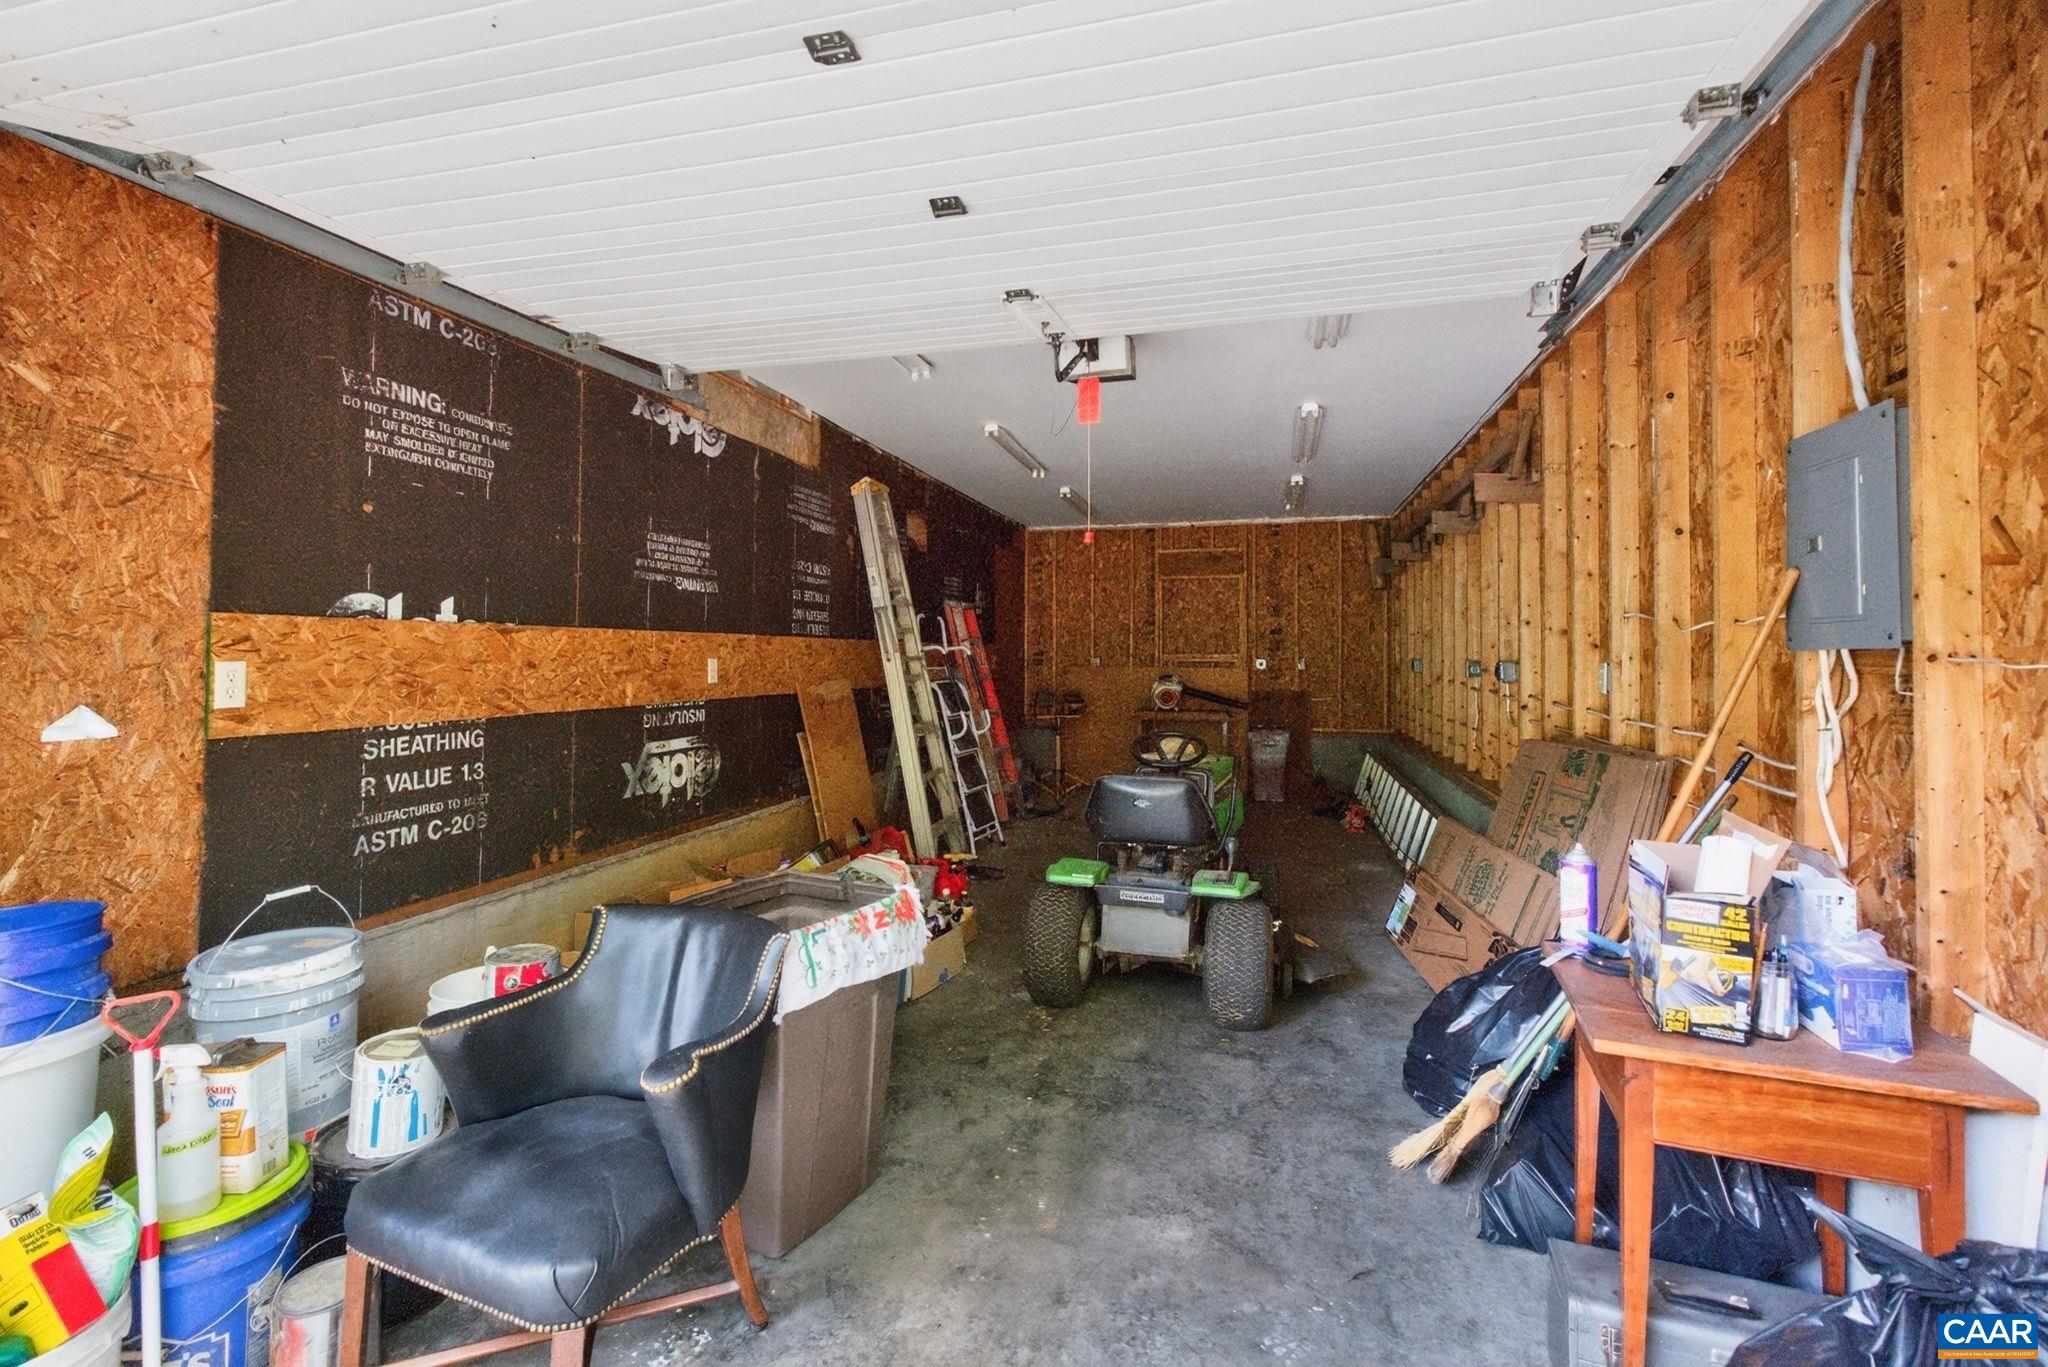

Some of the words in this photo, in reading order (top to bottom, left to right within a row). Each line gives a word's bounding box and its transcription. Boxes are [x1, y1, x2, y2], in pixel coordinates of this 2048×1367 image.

[368, 288, 431, 330] ASTM
[341, 366, 446, 415] WARNING:
[342, 395, 361, 409] DO
[364, 401, 389, 416] NOT
[392, 408, 435, 428] EXPOSE
[438, 421, 451, 434] TO
[453, 427, 479, 441] OPEN
[382, 419, 398, 433] OR
[364, 428, 389, 443] MAY
[394, 433, 444, 456] SMOLDER
[364, 442, 432, 467] EXTINGUISH
[434, 457, 494, 480] COMPLETELY
[362, 729, 485, 760] SHEATHING
[361, 777, 376, 797] R
[386, 766, 452, 793] VALUE
[461, 762, 485, 781] 1.3
[354, 824, 419, 856] ASTM
